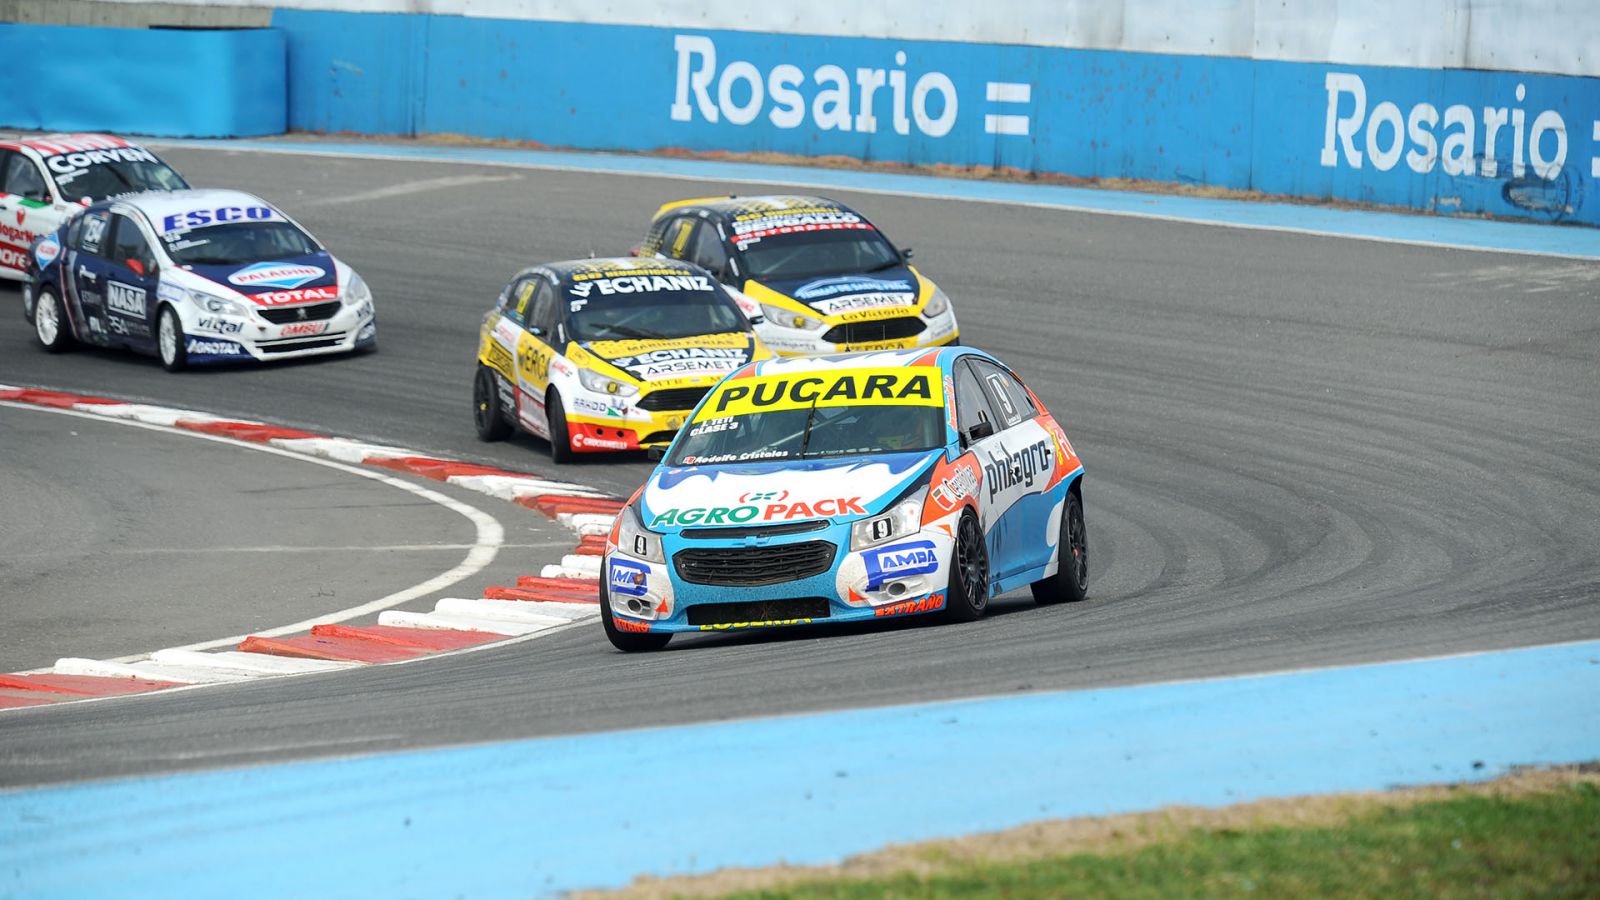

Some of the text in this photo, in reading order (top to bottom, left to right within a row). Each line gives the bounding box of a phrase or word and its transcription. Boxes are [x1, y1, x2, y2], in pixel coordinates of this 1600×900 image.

[671, 34, 959, 138] Rosario
[1321, 72, 1568, 180] Rosario
[48, 148, 160, 174] CORVEN
[164, 207, 272, 232] ESCO
[237, 267, 319, 282] PALADINI
[594, 276, 714, 296] ECHANIZ
[110, 287, 145, 314] NASA
[257, 289, 336, 305] TOTAL
[829, 295, 906, 311] ARSEMET
[647, 361, 732, 375] ARSEMET
[716, 375, 933, 412] PUCARA
[992, 378, 1013, 414] 9
[650, 496, 867, 526] AGRO PACK
[876, 521, 889, 538] 9
[636, 537, 645, 552] 9
